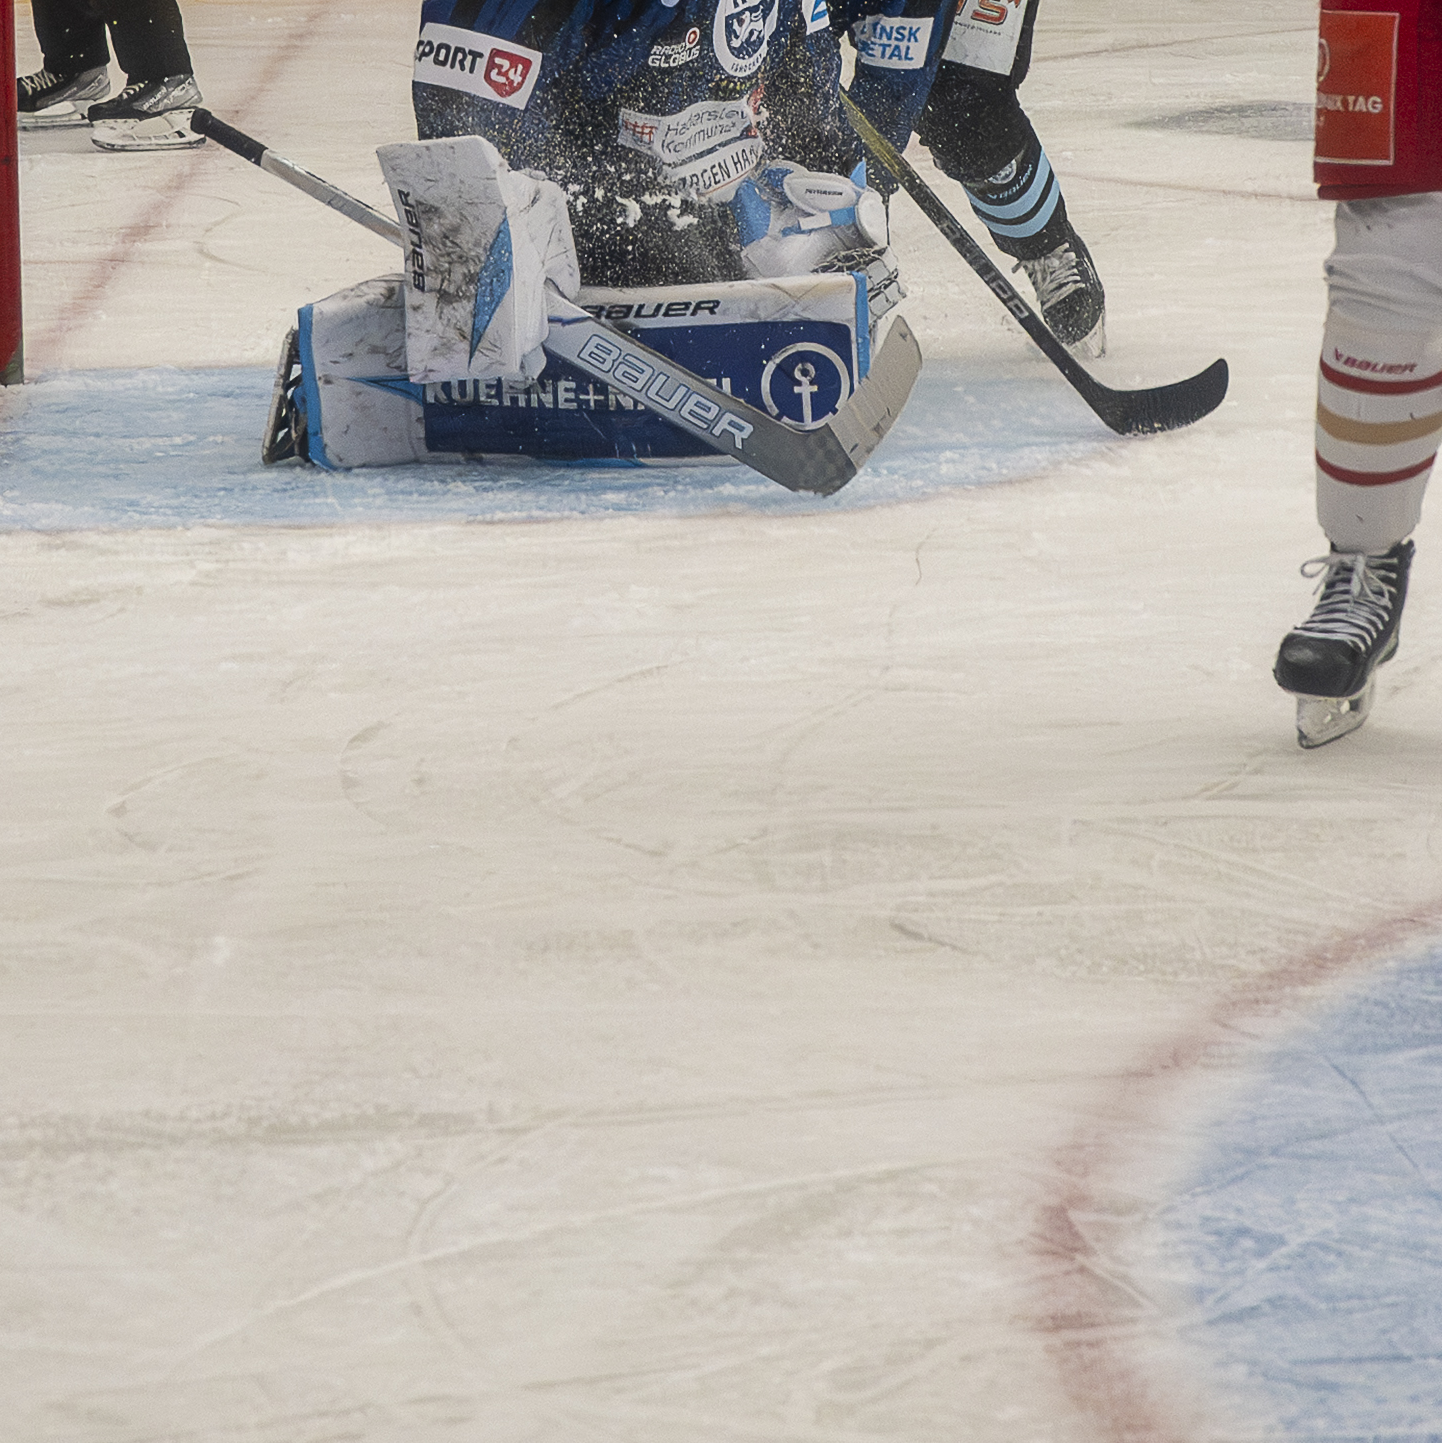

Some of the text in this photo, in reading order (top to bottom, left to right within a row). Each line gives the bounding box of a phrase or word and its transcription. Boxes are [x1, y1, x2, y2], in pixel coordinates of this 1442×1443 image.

[489, 57, 525, 87] 24
[1348, 95, 1383, 114] TAG
[398, 189, 426, 293] BAUER
[577, 333, 756, 450] BAUER
